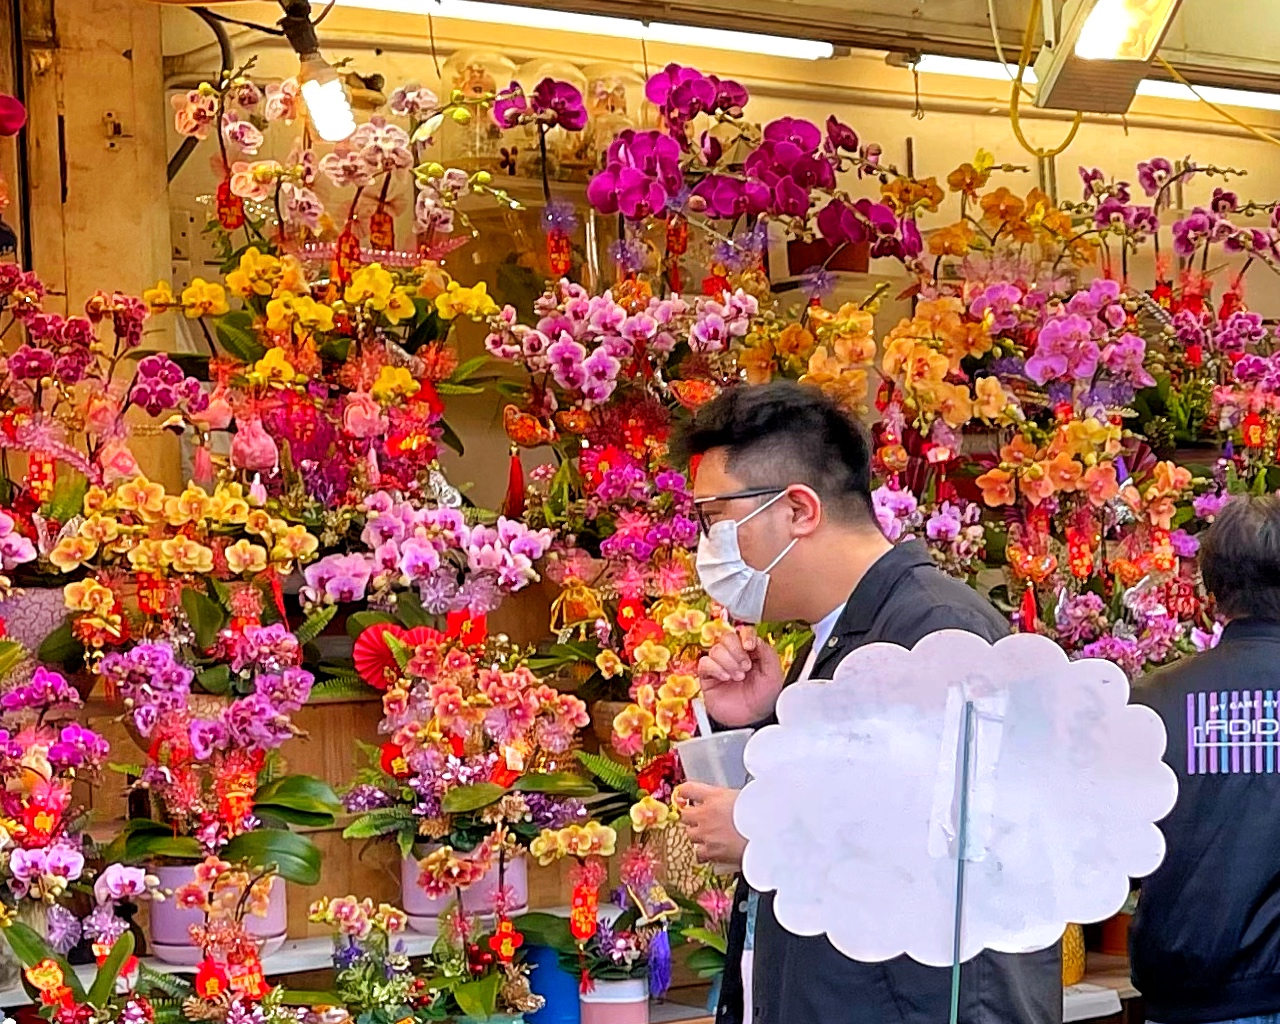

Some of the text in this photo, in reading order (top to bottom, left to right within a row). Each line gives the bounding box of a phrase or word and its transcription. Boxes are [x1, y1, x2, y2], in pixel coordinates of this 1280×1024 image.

[1210, 703, 1226, 713] MY
[1230, 700, 1259, 711] GAME
[1264, 700, 1279, 709] MY
